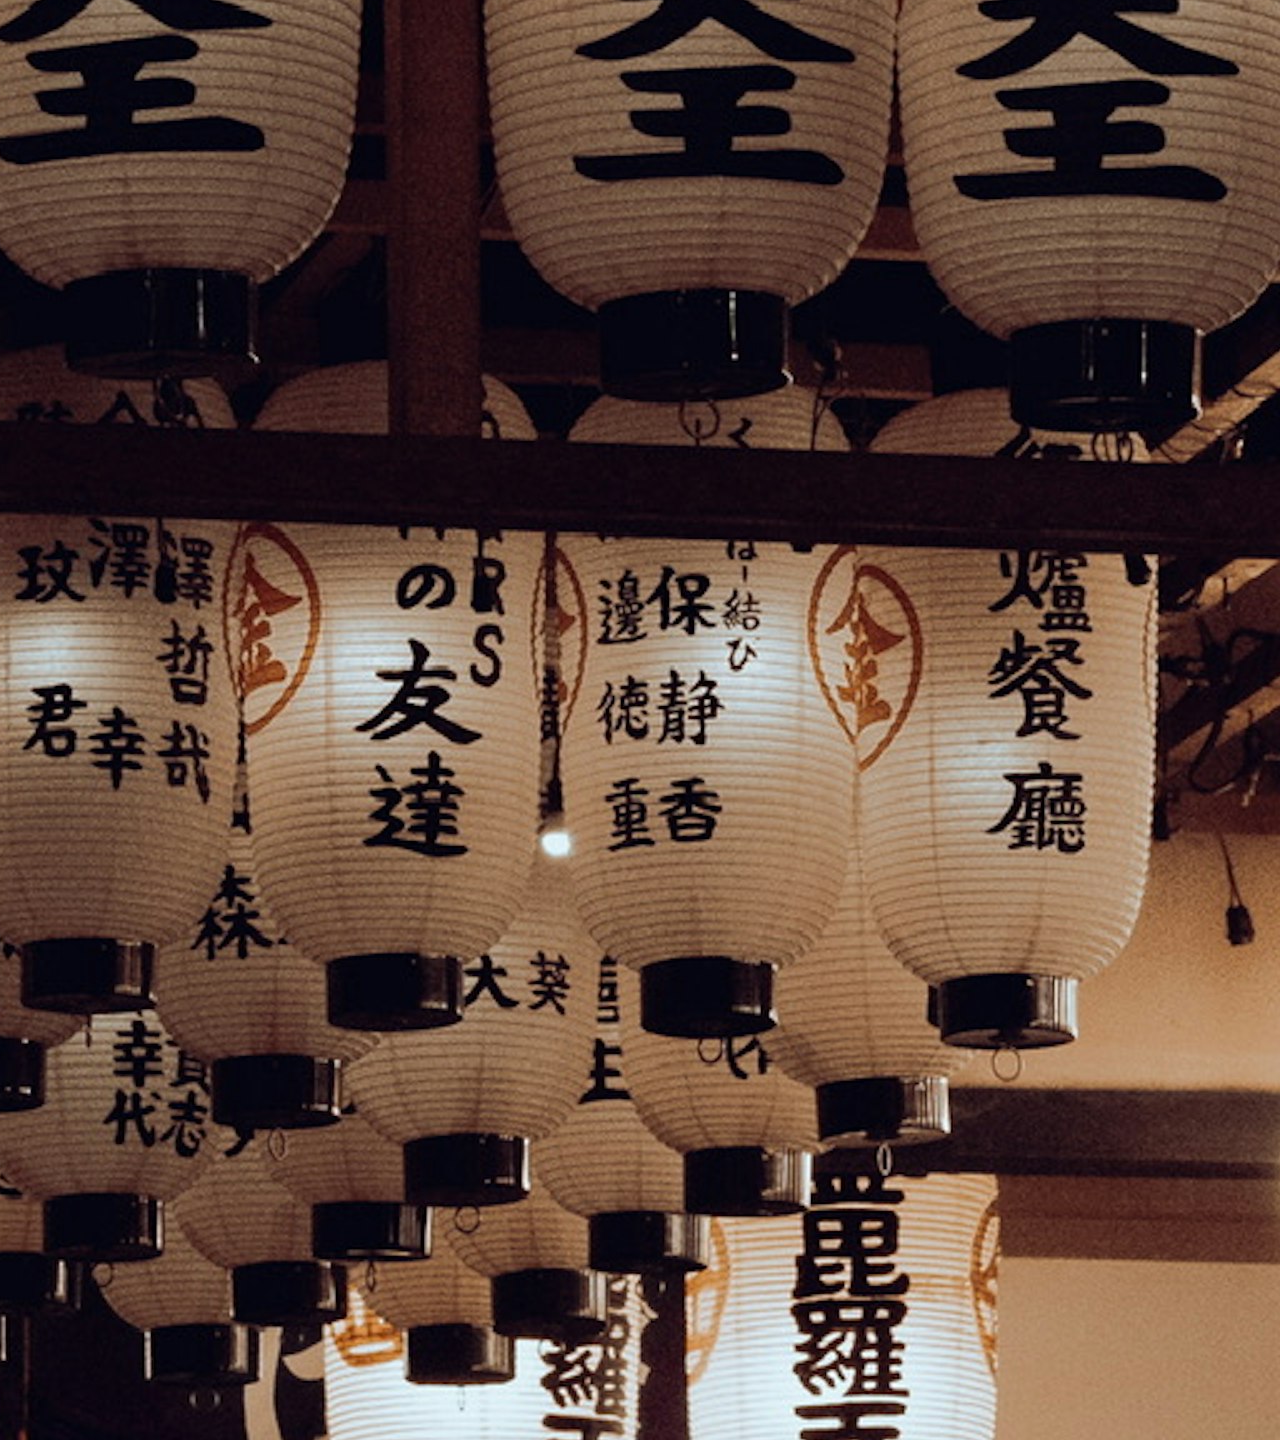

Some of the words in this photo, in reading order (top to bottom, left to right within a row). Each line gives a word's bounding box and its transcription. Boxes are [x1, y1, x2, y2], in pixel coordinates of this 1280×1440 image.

[354, 526, 484, 857] の友達
[470, 528, 507, 688] RS
